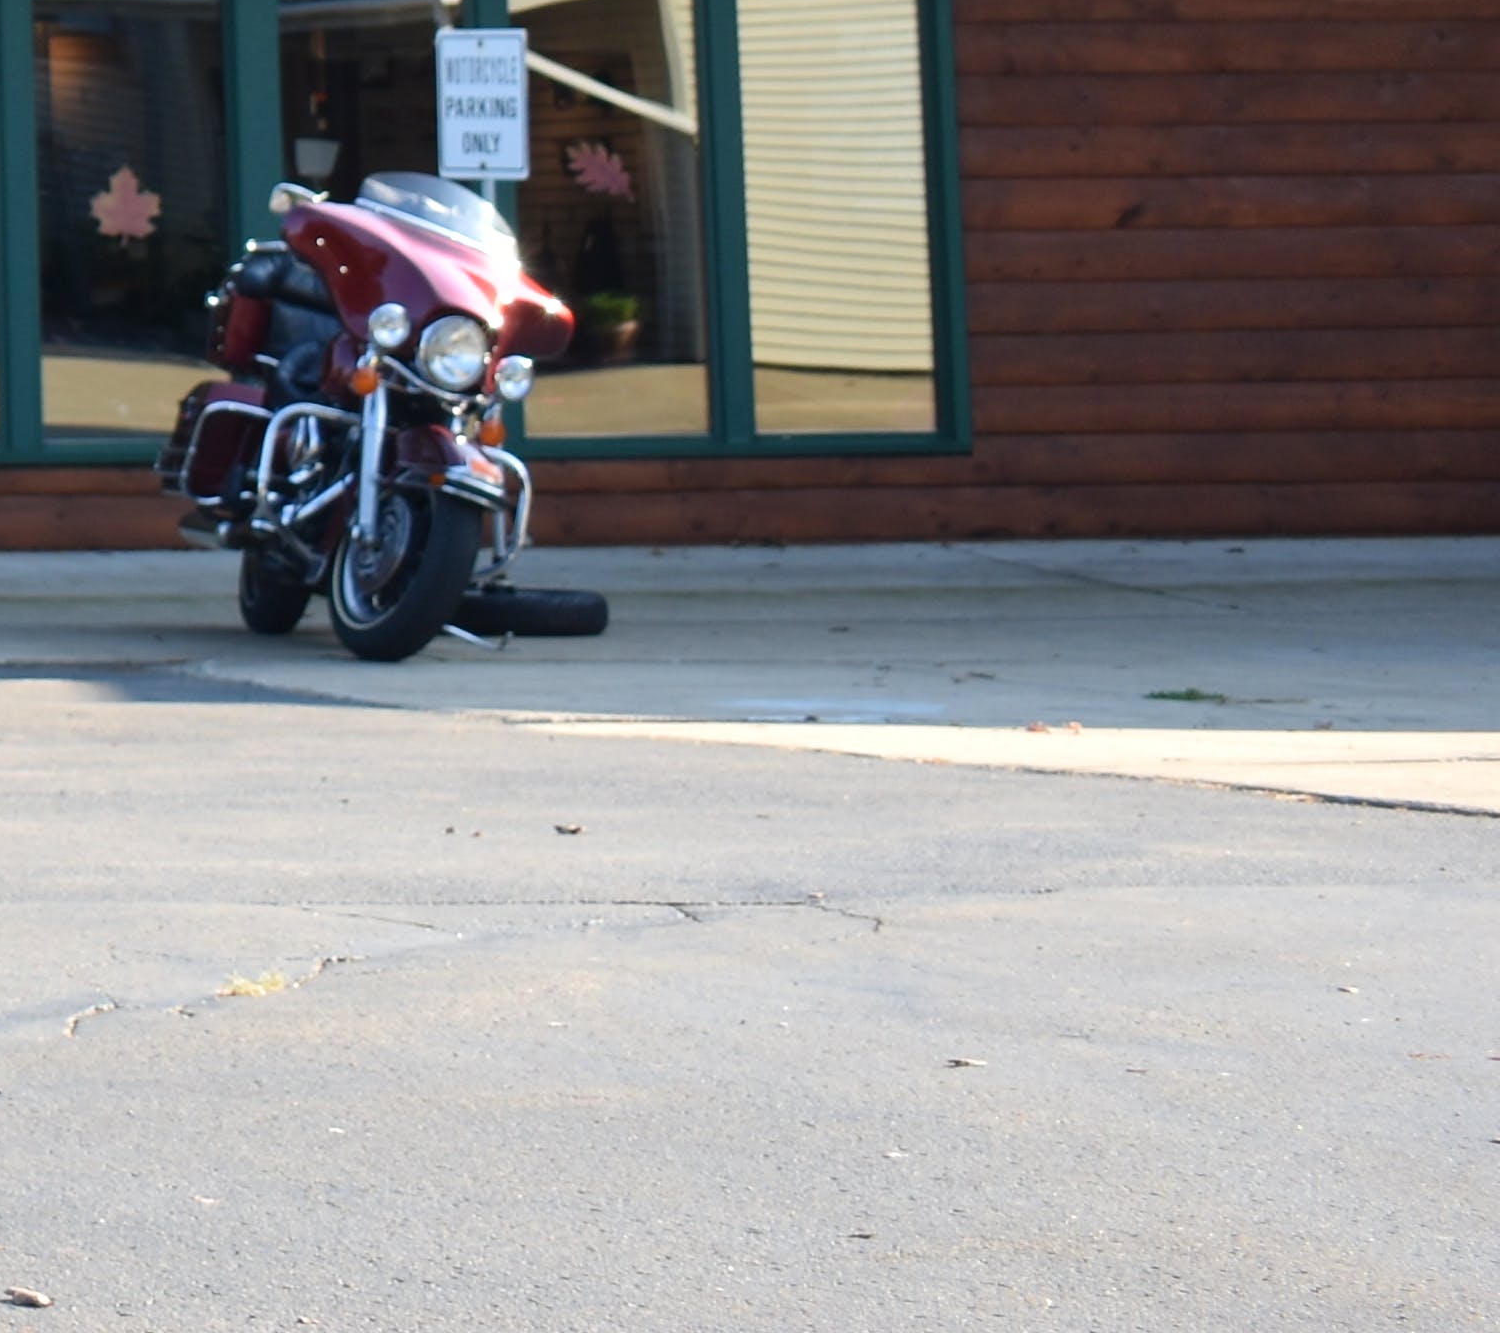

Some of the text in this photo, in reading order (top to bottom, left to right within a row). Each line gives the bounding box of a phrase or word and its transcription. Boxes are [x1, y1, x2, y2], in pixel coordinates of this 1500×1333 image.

[444, 56, 518, 84] MOTORCYCLE
[444, 96, 518, 118] PARKING
[461, 132, 501, 154] ONLY
